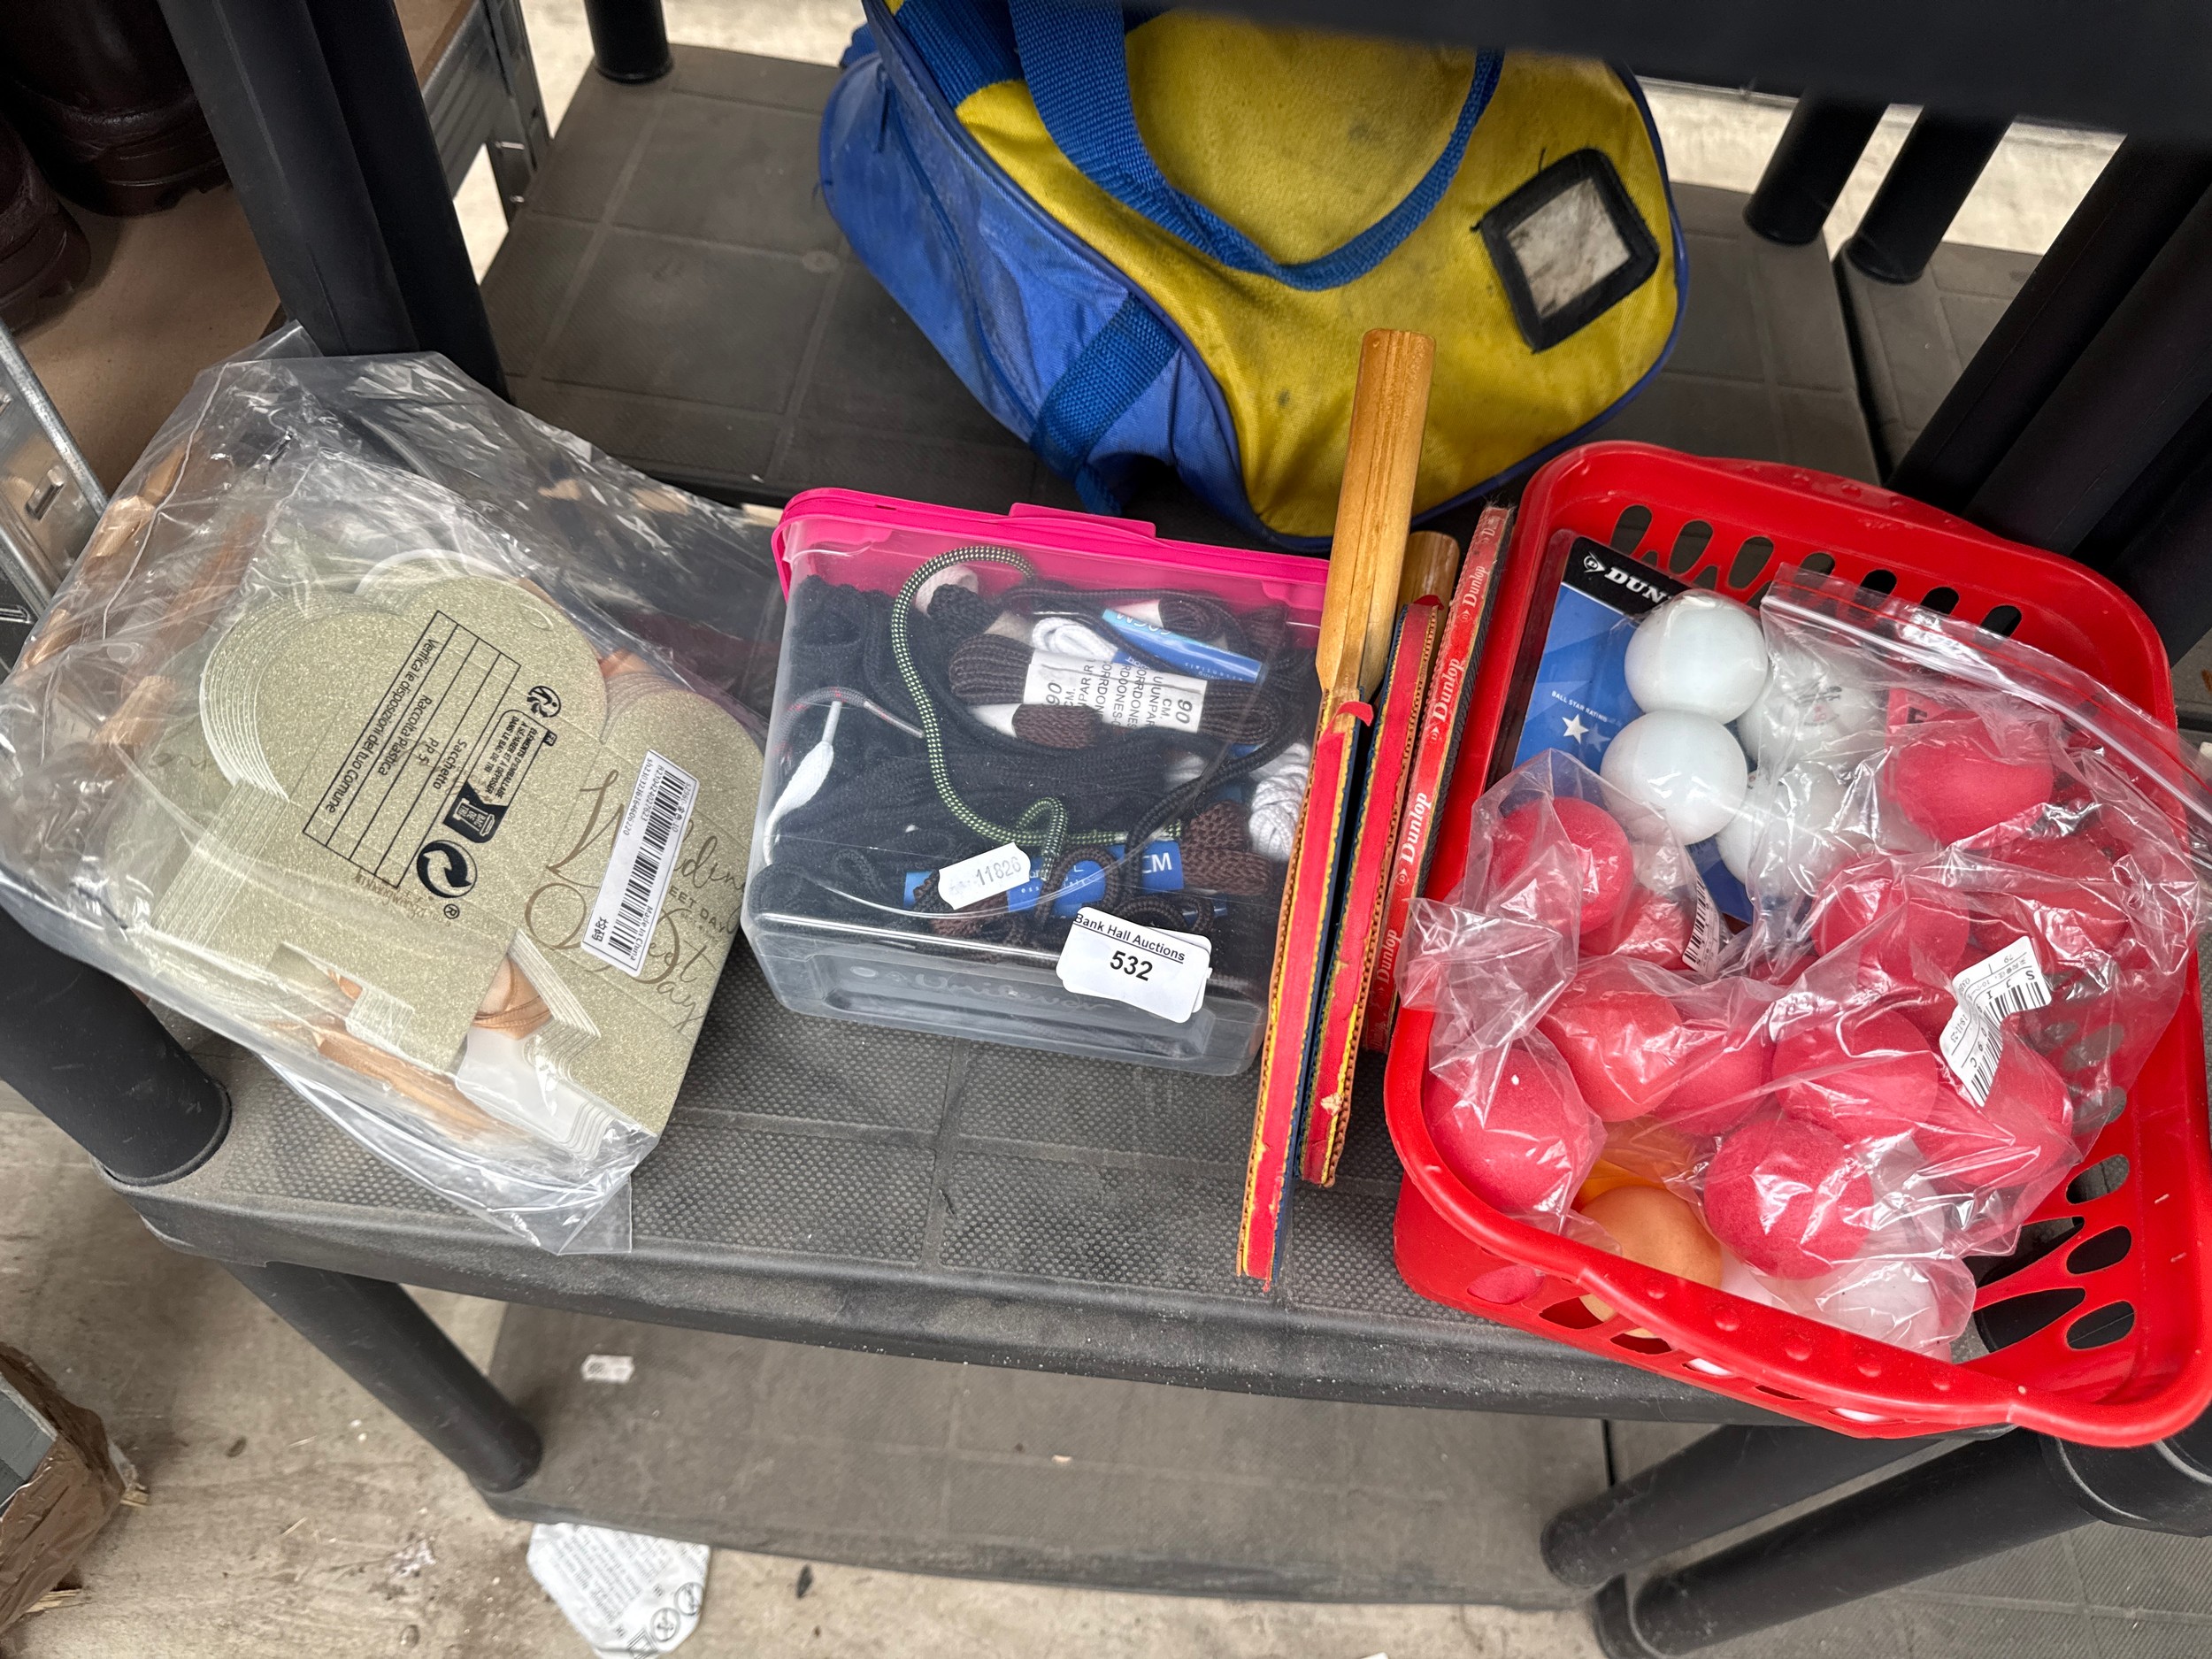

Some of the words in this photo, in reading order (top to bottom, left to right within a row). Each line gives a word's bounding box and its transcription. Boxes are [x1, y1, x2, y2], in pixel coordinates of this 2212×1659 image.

[1462, 565, 1490, 608] Dunlop
[1604, 566, 1674, 603] DUN
[411, 637, 439, 672] Verifica
[404, 670, 419, 683] le
[1432, 657, 1465, 722] Dunlop
[1551, 690, 1568, 703] BALL
[1568, 698, 1585, 711] STAR
[373, 679, 412, 734] disposizioni
[400, 694, 432, 737] Raccolta
[1174, 699, 1193, 724] 90
[501, 732, 511, 741] LE
[507, 716, 519, 733] DANS
[362, 733, 380, 753] del
[424, 737, 438, 753] PP
[495, 739, 506, 753] BAC
[351, 751, 368, 770] tuo
[378, 736, 407, 776] Plastica
[433, 739, 467, 790] Sacchetto
[484, 762, 495, 772] TRI
[490, 752, 499, 762] DE
[503, 752, 511, 761] ET
[326, 769, 358, 813] Comune
[1400, 792, 1432, 864] Dunlop
[640, 905, 653, 927] Made
[666, 885, 698, 909] EET
[696, 907, 727, 933] DAY
[637, 927, 646, 937] In
[1074, 914, 1104, 933] Bank
[1107, 923, 1132, 941] Hall
[1133, 932, 1186, 962] Auctions
[629, 938, 642, 961] China
[1376, 929, 1401, 984] Dunlop
[1110, 950, 1154, 982] 532
